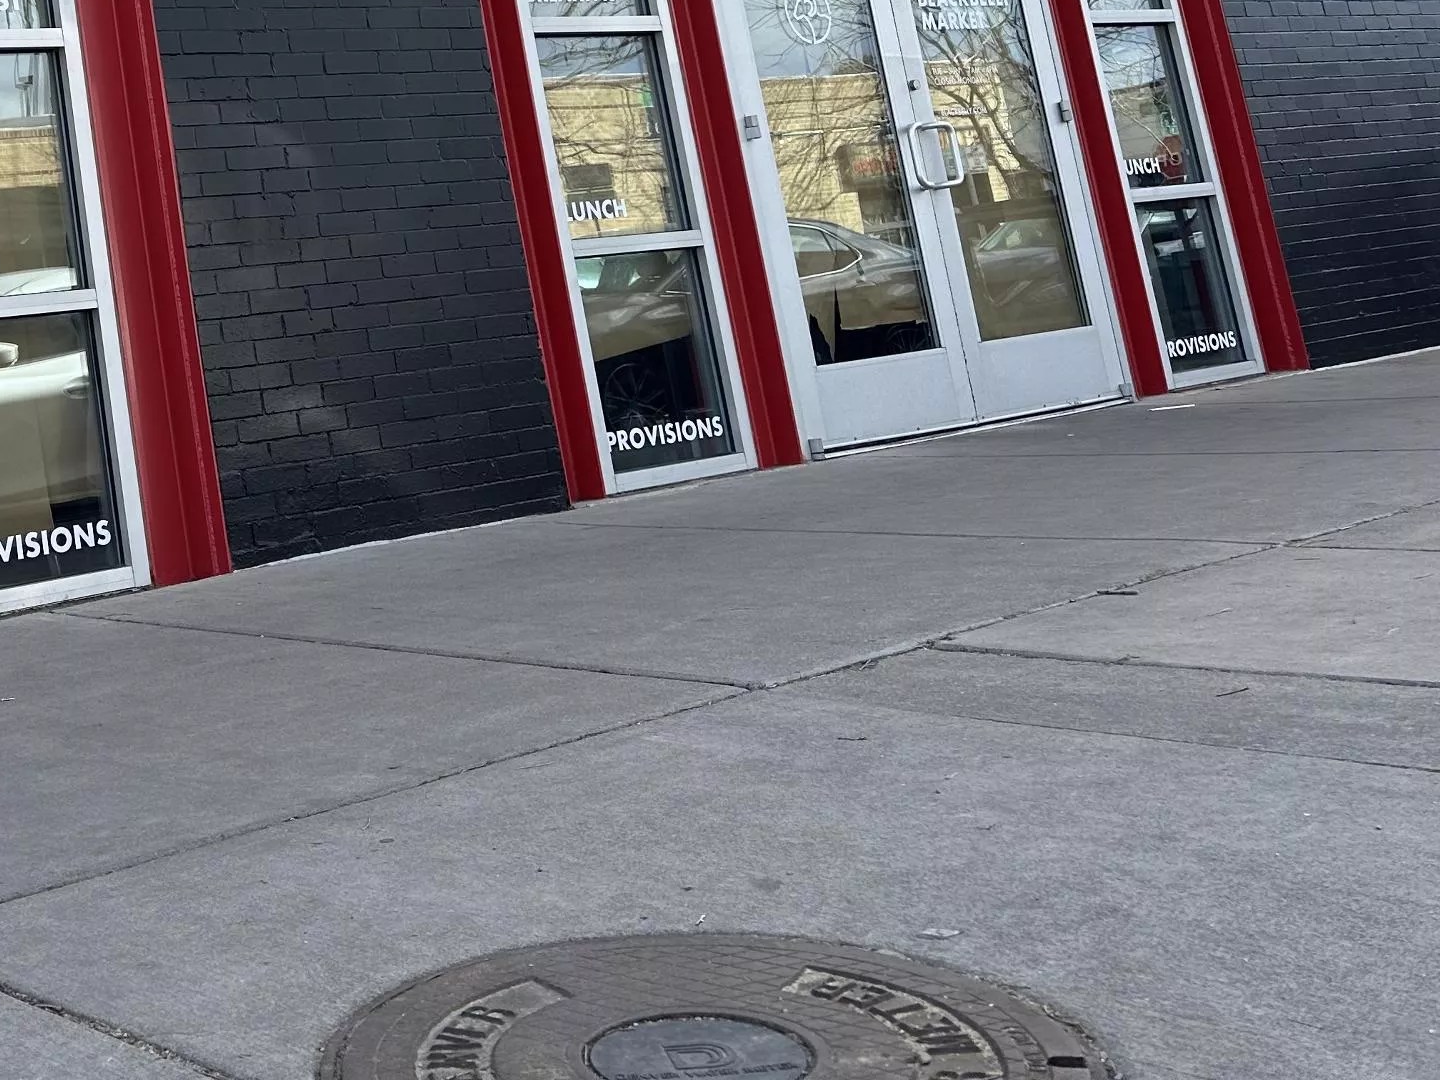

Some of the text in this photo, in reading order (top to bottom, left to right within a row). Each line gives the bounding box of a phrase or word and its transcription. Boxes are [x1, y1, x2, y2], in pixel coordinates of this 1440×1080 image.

[922, 11, 989, 30] MARKET
[1124, 157, 1161, 175] UNCH
[1166, 330, 1237, 358] ROVISIONS
[606, 415, 723, 453] PROVISIONS
